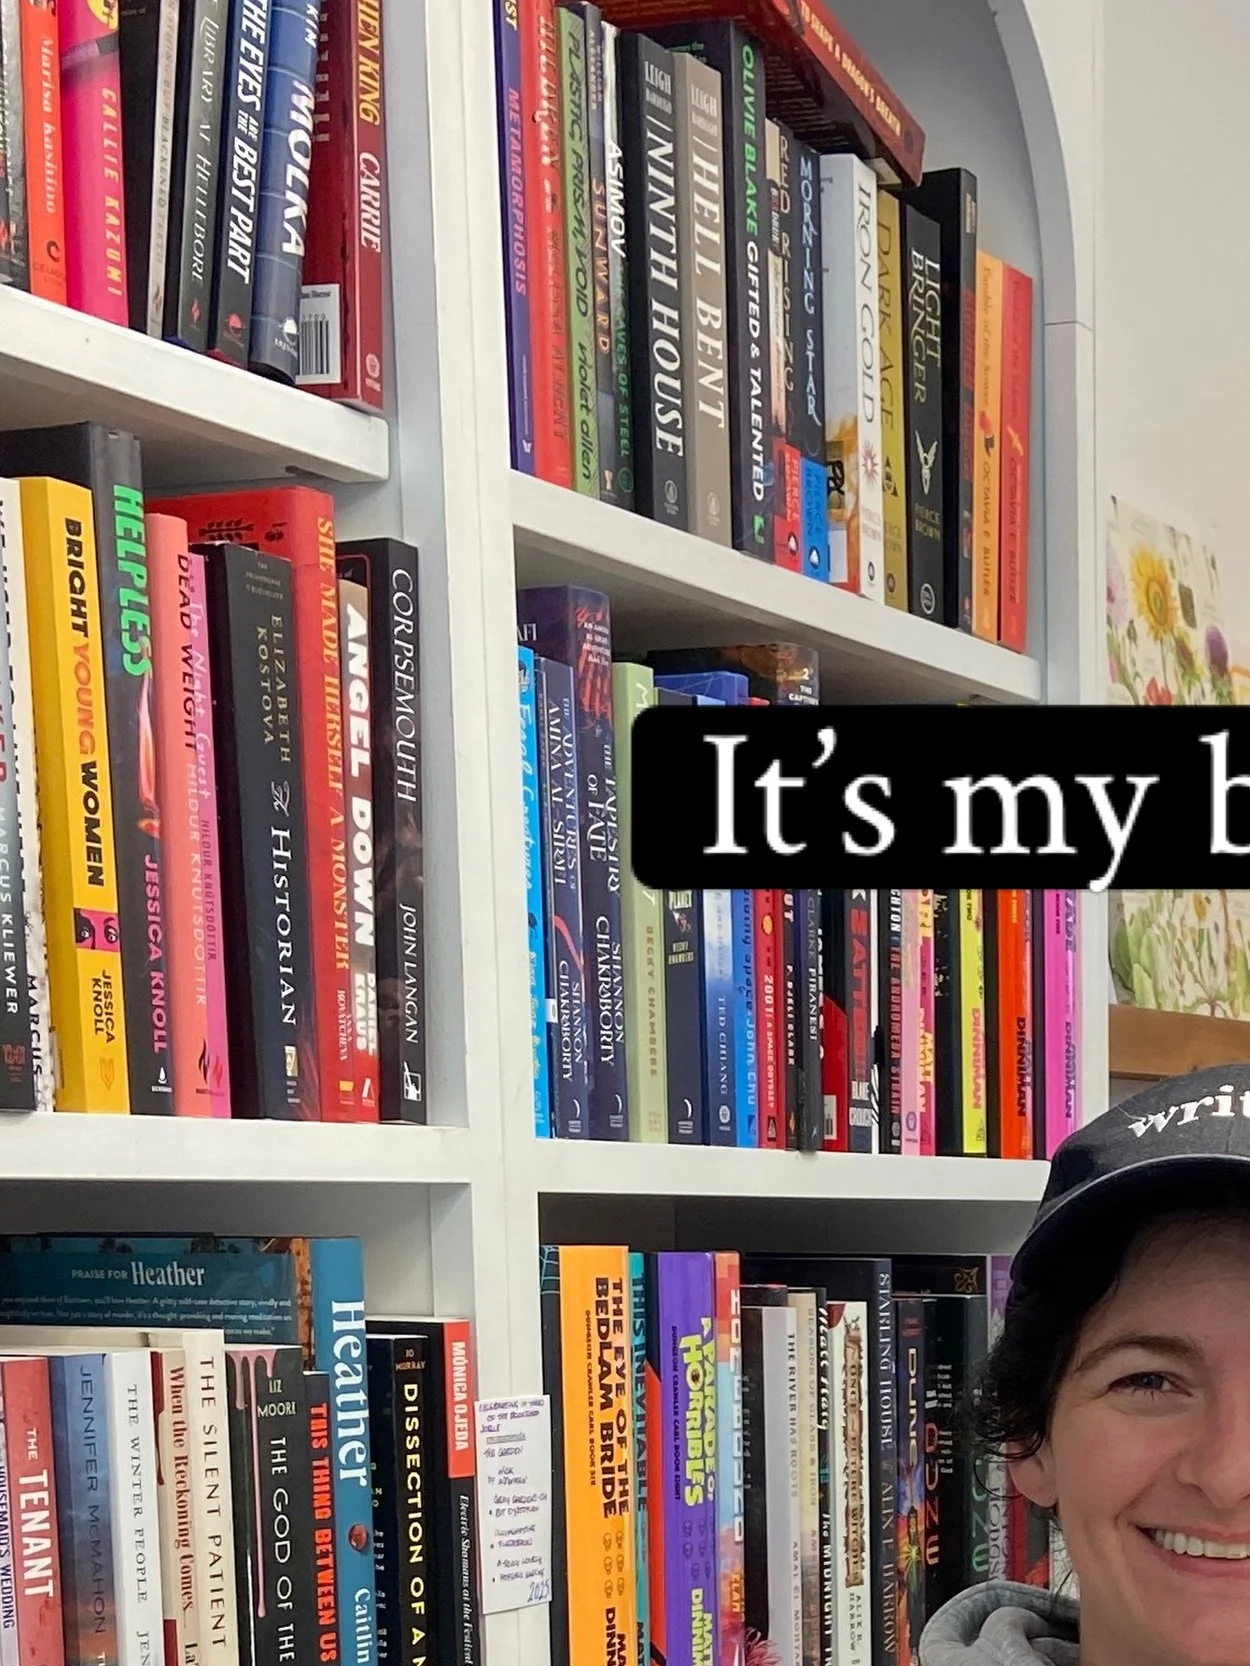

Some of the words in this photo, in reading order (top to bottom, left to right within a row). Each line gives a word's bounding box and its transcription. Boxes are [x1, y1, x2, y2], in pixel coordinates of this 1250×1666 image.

[239, 41, 263, 110] EYES
[739, 45, 757, 140] OLIVIE
[102, 87, 117, 182] CALLIE
[231, 137, 256, 207] BEST
[281, 80, 317, 256] MOLKA
[359, 151, 380, 252] CARRIE
[508, 90, 526, 296] METAMORPHOSIS
[607, 138, 628, 258] ASIMOV
[647, 134, 676, 291] NINTH
[692, 151, 722, 276] HELL
[743, 148, 758, 236] BLAKE
[855, 182, 873, 295] IRON
[104, 195, 122, 296] KAZUMI
[227, 209, 253, 283] PART
[745, 240, 761, 339] GIFTED
[651, 298, 684, 456] HOUSE
[696, 293, 724, 428] BENT
[748, 346, 760, 359] &
[859, 305, 875, 424] GOLD
[748, 368, 763, 500] TALENTED
[64, 519, 88, 638] BRIGHT
[113, 484, 152, 676] HELPLESS
[72, 643, 96, 755] YOUNG
[345, 603, 370, 777] ANGEL
[391, 569, 416, 803] CORPSEMOUTH
[79, 760, 104, 887] WOMEN
[352, 796, 374, 946] DOWN
[271, 826, 296, 1026] HISTORIAN
[91, 974, 105, 1037] KNOLL
[102, 969, 115, 1044] JESSICA
[808, 968, 818, 1041] PIRANESI
[132, 1261, 205, 1287] Heather
[611, 1277, 623, 1341] THE
[200, 1357, 216, 1408] THE
[269, 1380, 282, 1393] LIZ
[332, 1301, 368, 1486] Heather
[594, 1277, 611, 1415] BEDLAM
[613, 1345, 625, 1398] EYE
[26, 1427, 39, 1461] THE
[257, 1402, 296, 1417] MOORE
[270, 1437, 288, 1474] THE
[310, 1403, 328, 1449] THIS
[453, 1406, 469, 1451] OJEDA
[615, 1407, 626, 1443] OF
[202, 1426, 221, 1517] SILENT
[313, 1457, 332, 1520] THING
[403, 1384, 424, 1563] DISSECTION
[601, 1420, 616, 1519] BRIDE
[617, 1448, 629, 1515] THE
[18, 1468, 55, 1597] TENANT
[273, 1488, 291, 1564] GOD
[207, 1535, 226, 1646] PATIENT
[277, 1576, 293, 1610] OF
[315, 1528, 336, 1625] BETWEEN
[410, 1578, 425, 1615] OF
[278, 1623, 295, 1662] THE
[320, 1632, 337, 1662] US
[354, 1587, 370, 1664] Caitlin
[411, 1628, 426, 1645] A
